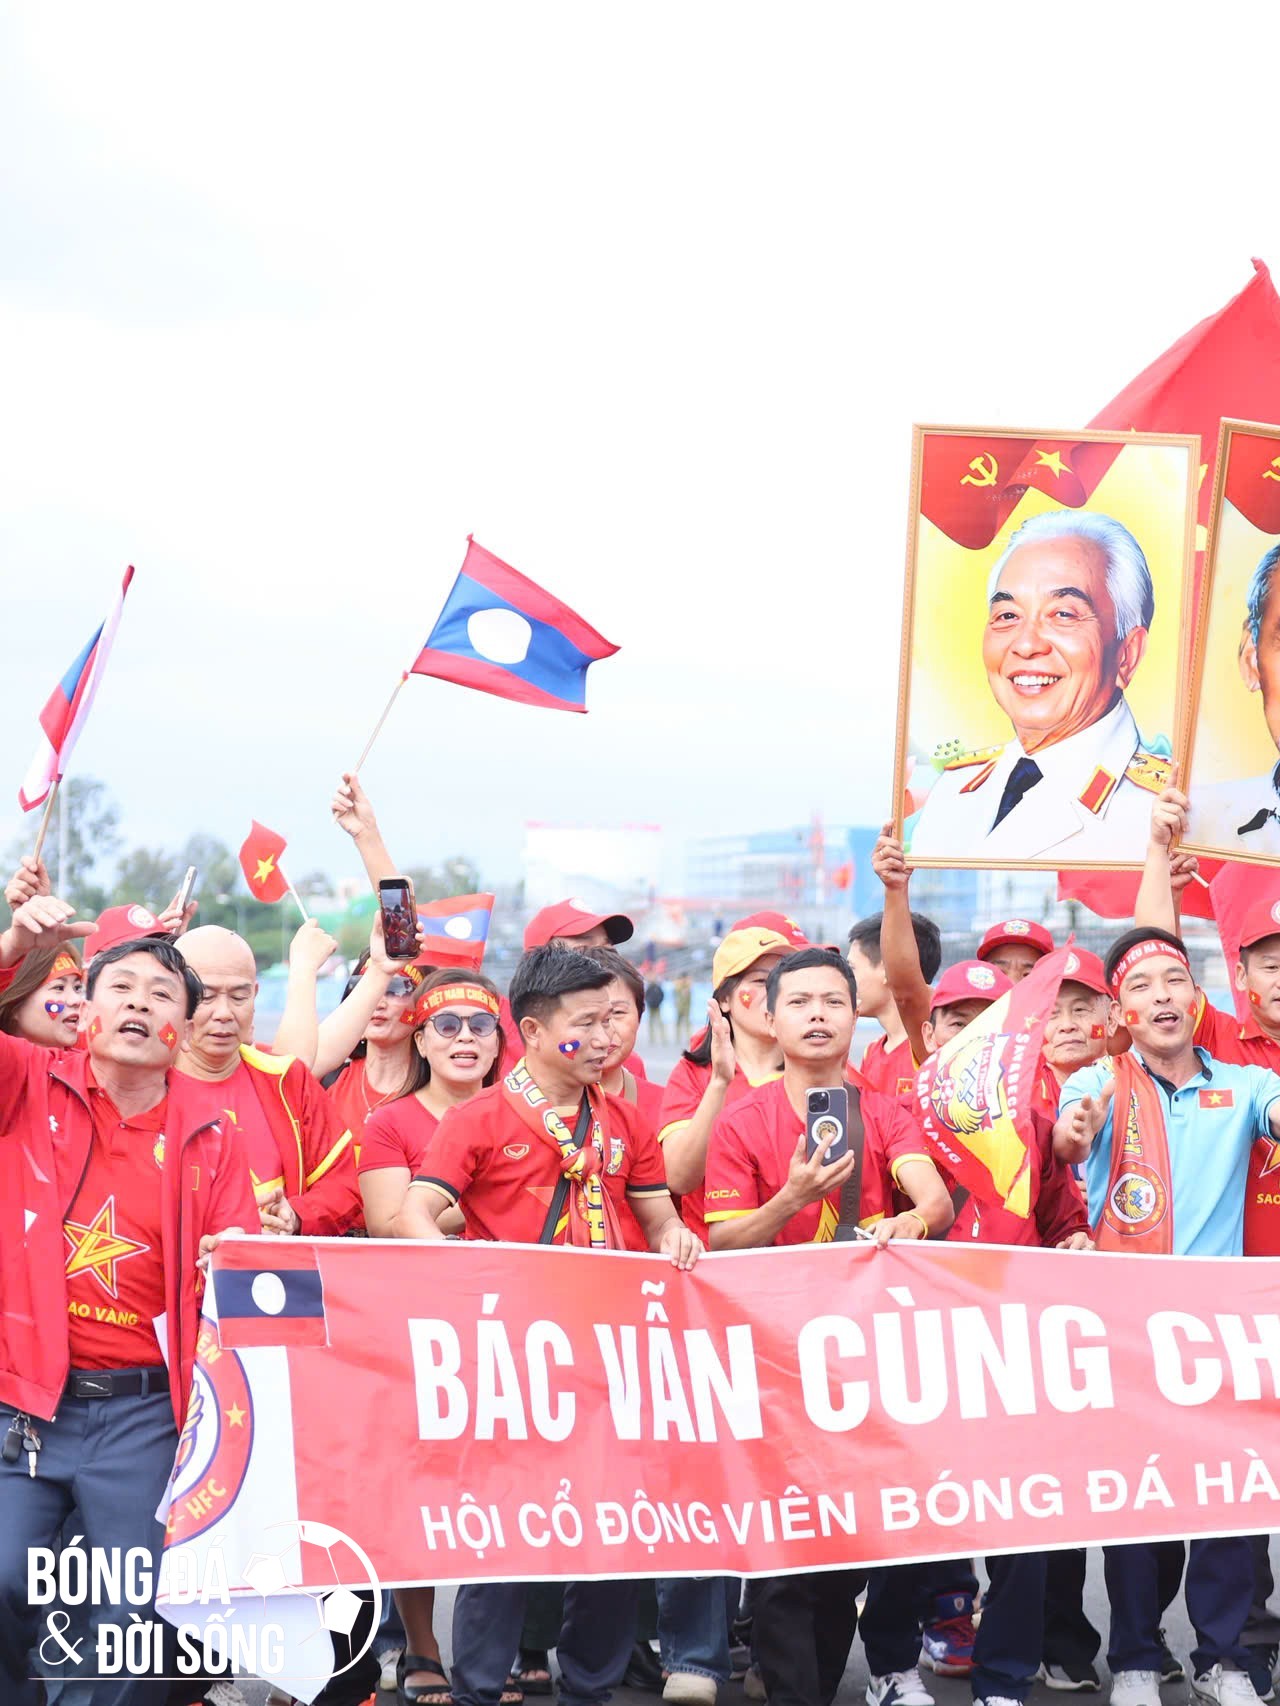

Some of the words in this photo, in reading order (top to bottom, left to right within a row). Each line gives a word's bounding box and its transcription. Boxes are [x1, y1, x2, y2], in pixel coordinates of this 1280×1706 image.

[427, 988, 443, 1009] VIỆT
[445, 987, 466, 1001] NAM
[68, 1301, 90, 1318] AO
[407, 1293, 576, 1442] BÁC
[593, 1280, 764, 1442] VẪN
[797, 1286, 1115, 1432] CÙNG
[184, 1478, 227, 1521] HFC
[420, 1493, 506, 1559] HỘI
[518, 1478, 583, 1548] CỔ
[595, 1489, 720, 1553] ĐỘNG
[722, 1484, 858, 1545] VIÊN
[880, 1470, 1065, 1531] BÓNG
[1085, 1453, 1176, 1514] ĐÁ
